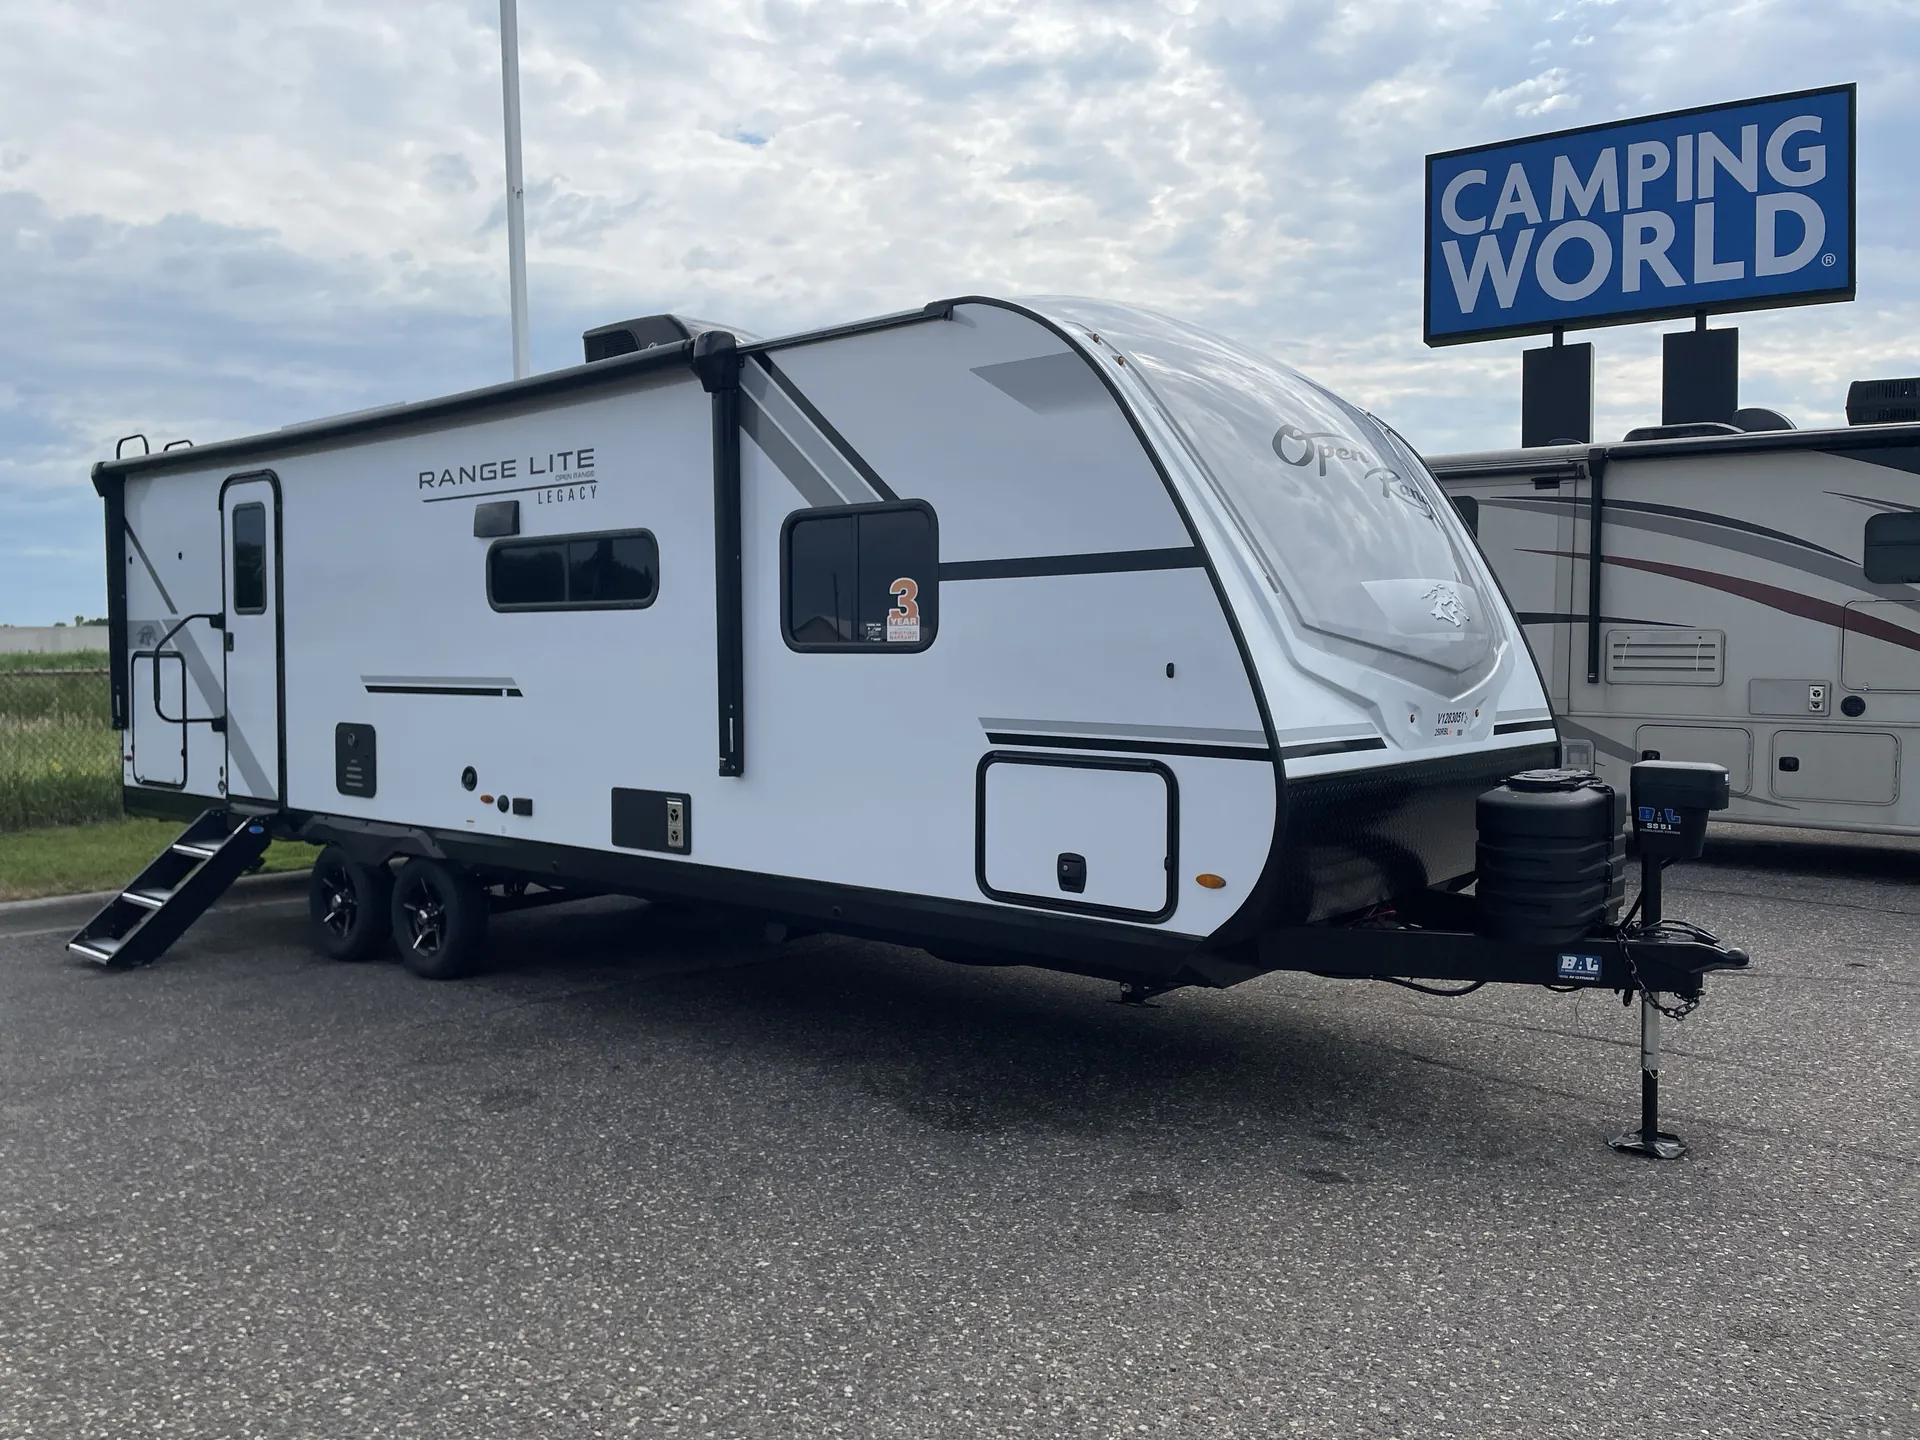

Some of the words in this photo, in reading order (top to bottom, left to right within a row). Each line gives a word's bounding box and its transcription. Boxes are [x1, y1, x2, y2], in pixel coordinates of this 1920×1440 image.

[1441, 115, 1826, 235] CAMPING
[1441, 192, 1826, 313] WORLD
[419, 459, 516, 489] RANGE
[529, 448, 595, 475] LITE
[1272, 424, 1370, 477] Open
[538, 485, 597, 504] LEGACY
[555, 473, 572, 481] OPEN
[573, 470, 595, 479] RANGE
[1365, 467, 1438, 521] Rang
[889, 577, 919, 618] 3
[890, 618, 917, 626] YEAR
